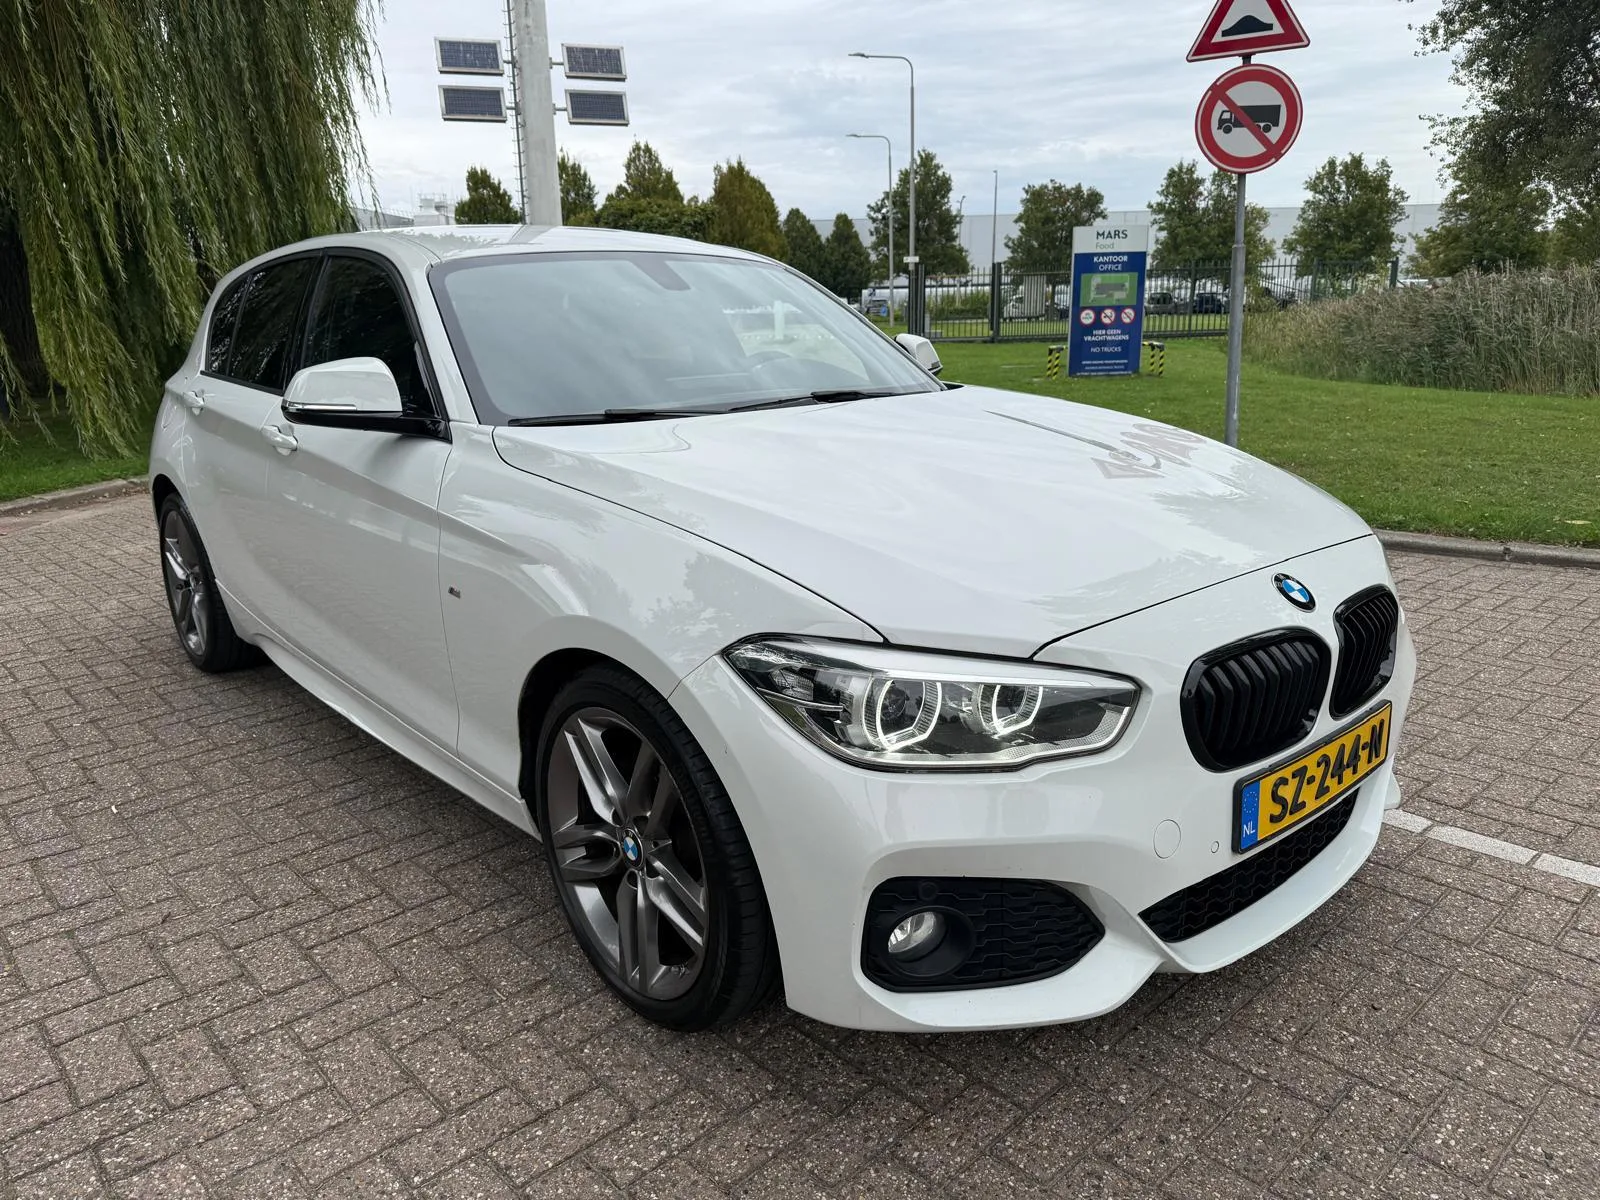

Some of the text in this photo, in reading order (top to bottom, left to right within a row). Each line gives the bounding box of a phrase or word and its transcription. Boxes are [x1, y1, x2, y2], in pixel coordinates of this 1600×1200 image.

[1096, 229, 1128, 240] MARS
[1095, 242, 1115, 250] Food
[1093, 255, 1128, 263] KANTOOR
[1098, 263, 1122, 271] OFFICE
[1084, 334, 1129, 342] VRACHTWAGENS
[1269, 718, 1385, 824] SZ-244-N
[1242, 820, 1256, 838] NL
